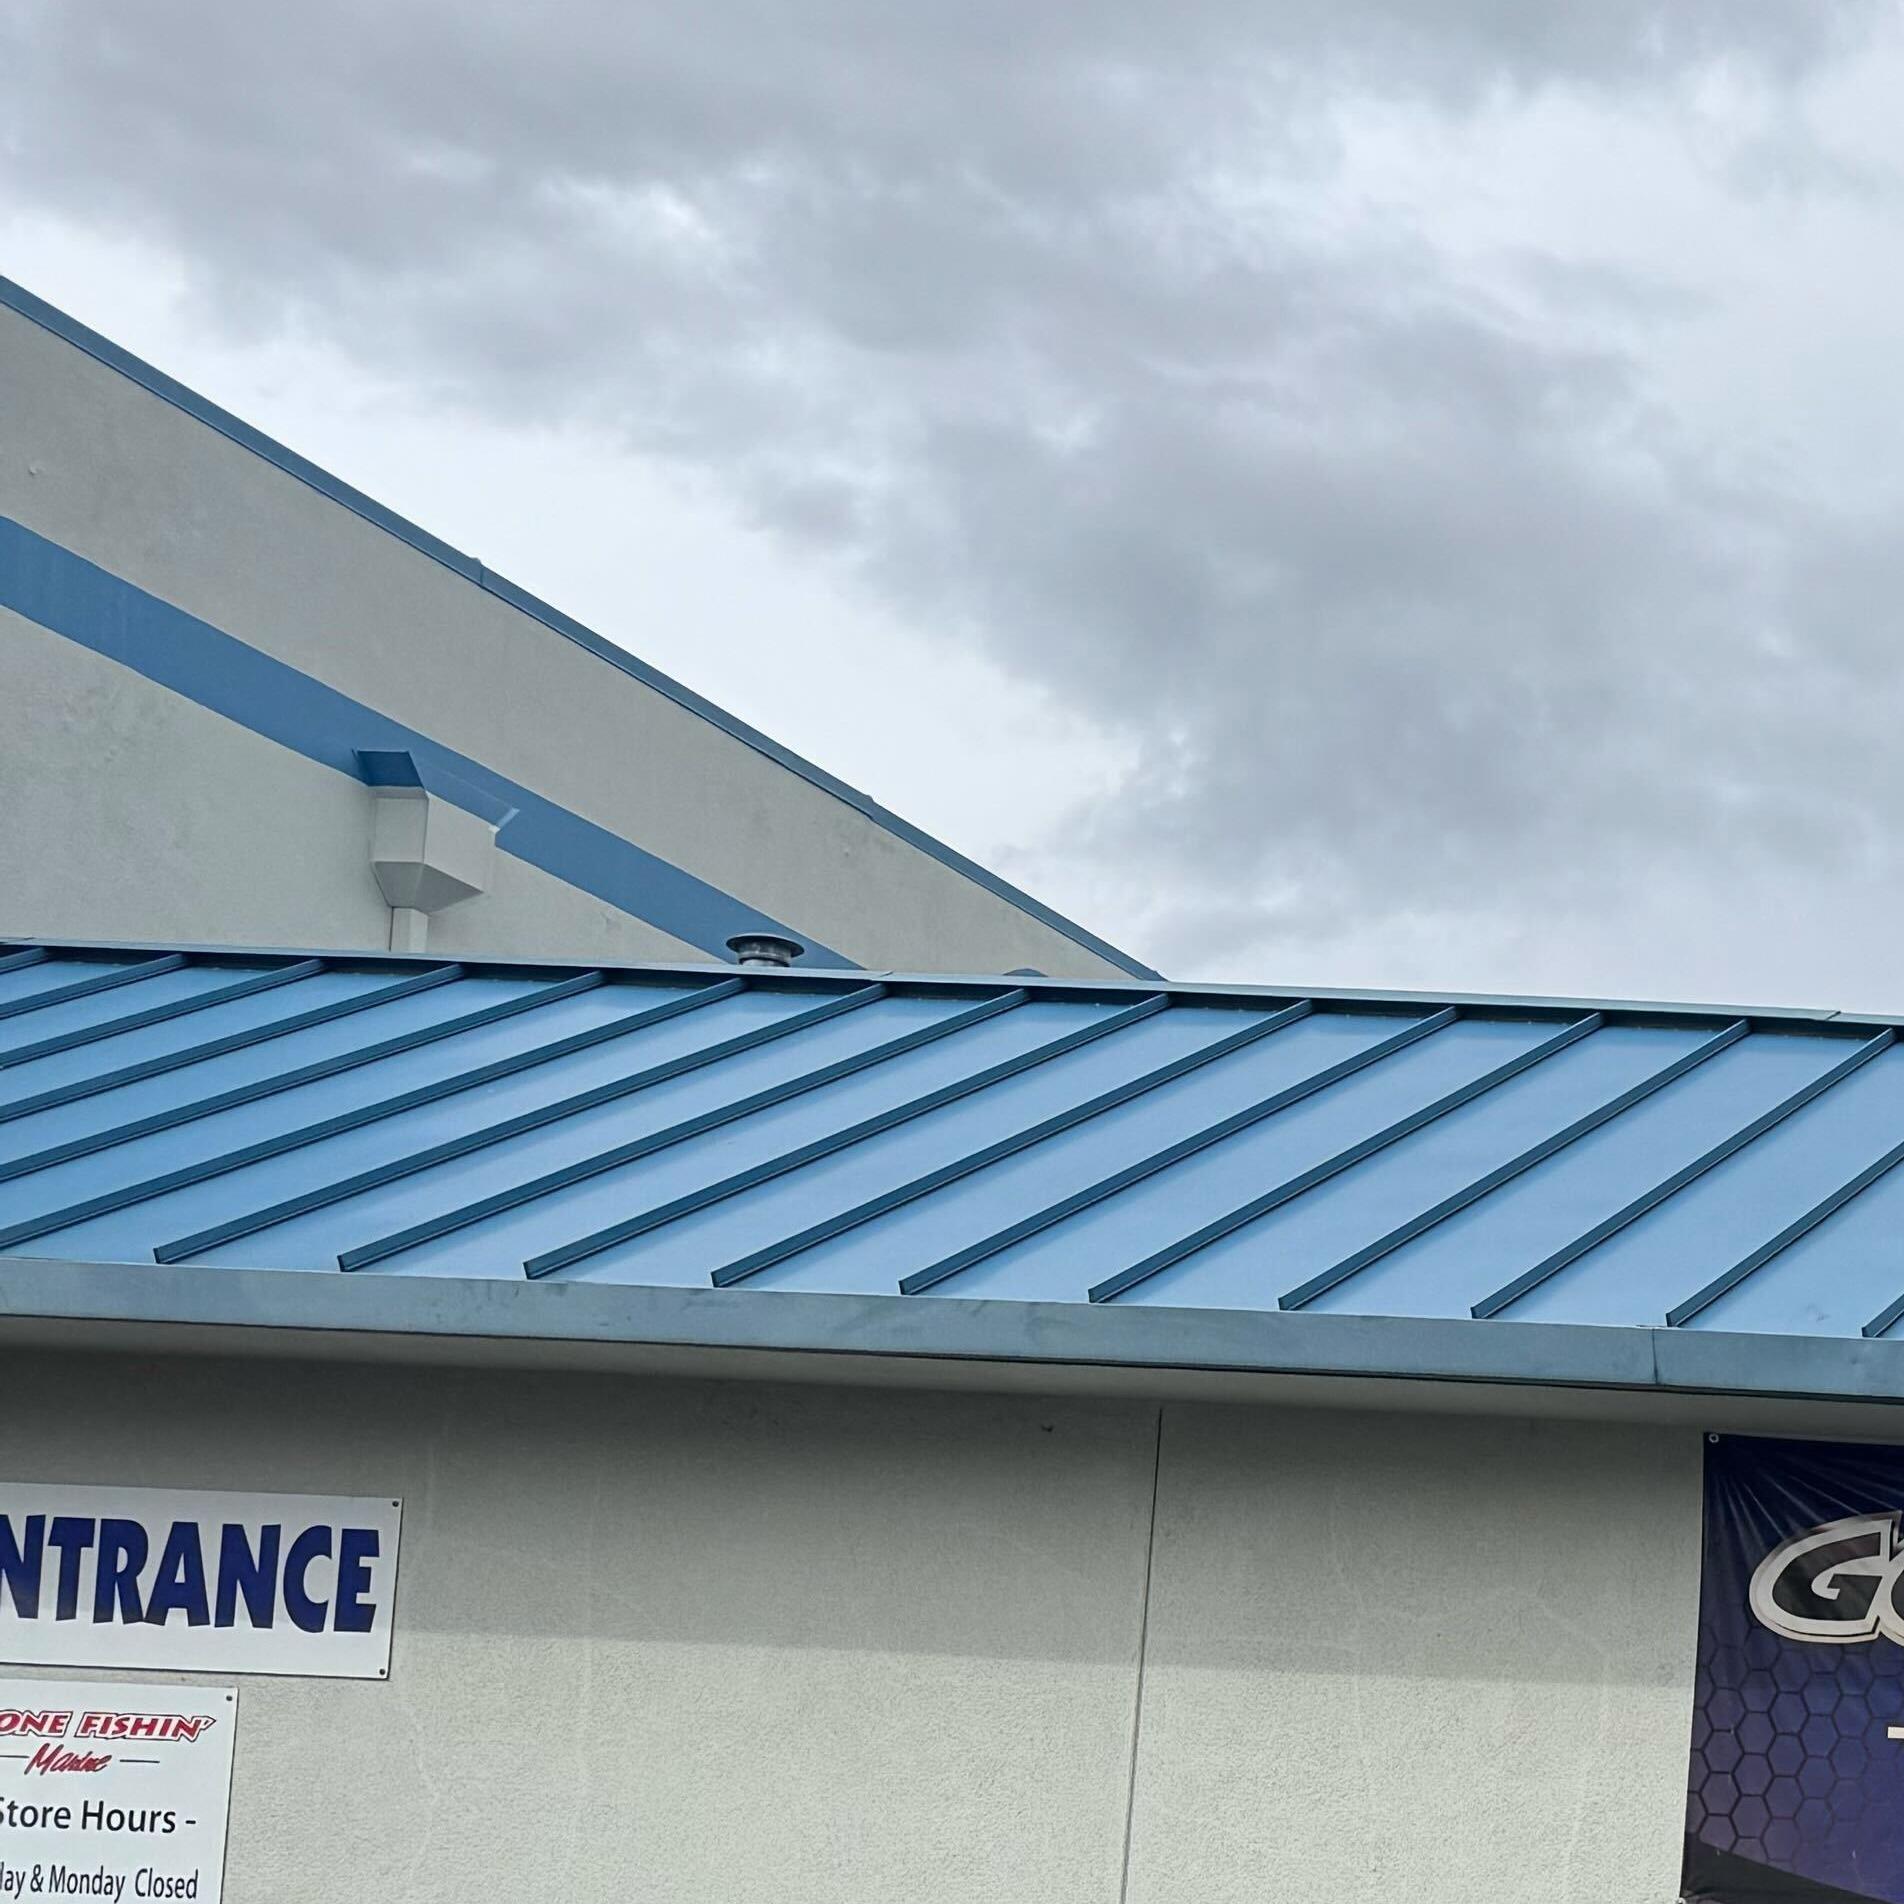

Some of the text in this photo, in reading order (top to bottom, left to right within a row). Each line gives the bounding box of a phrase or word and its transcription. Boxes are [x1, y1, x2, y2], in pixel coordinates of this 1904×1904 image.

[0, 1513, 381, 1633] NTRANCE
[0, 1709, 217, 1742] ONE FISHIN'
[24, 1743, 112, 1776] Marine
[0, 1796, 71, 1829] tore
[81, 1800, 176, 1834] Hours
[30, 1863, 44, 1892] &
[48, 1864, 126, 1904] Monday
[134, 1867, 199, 1899] Closed
